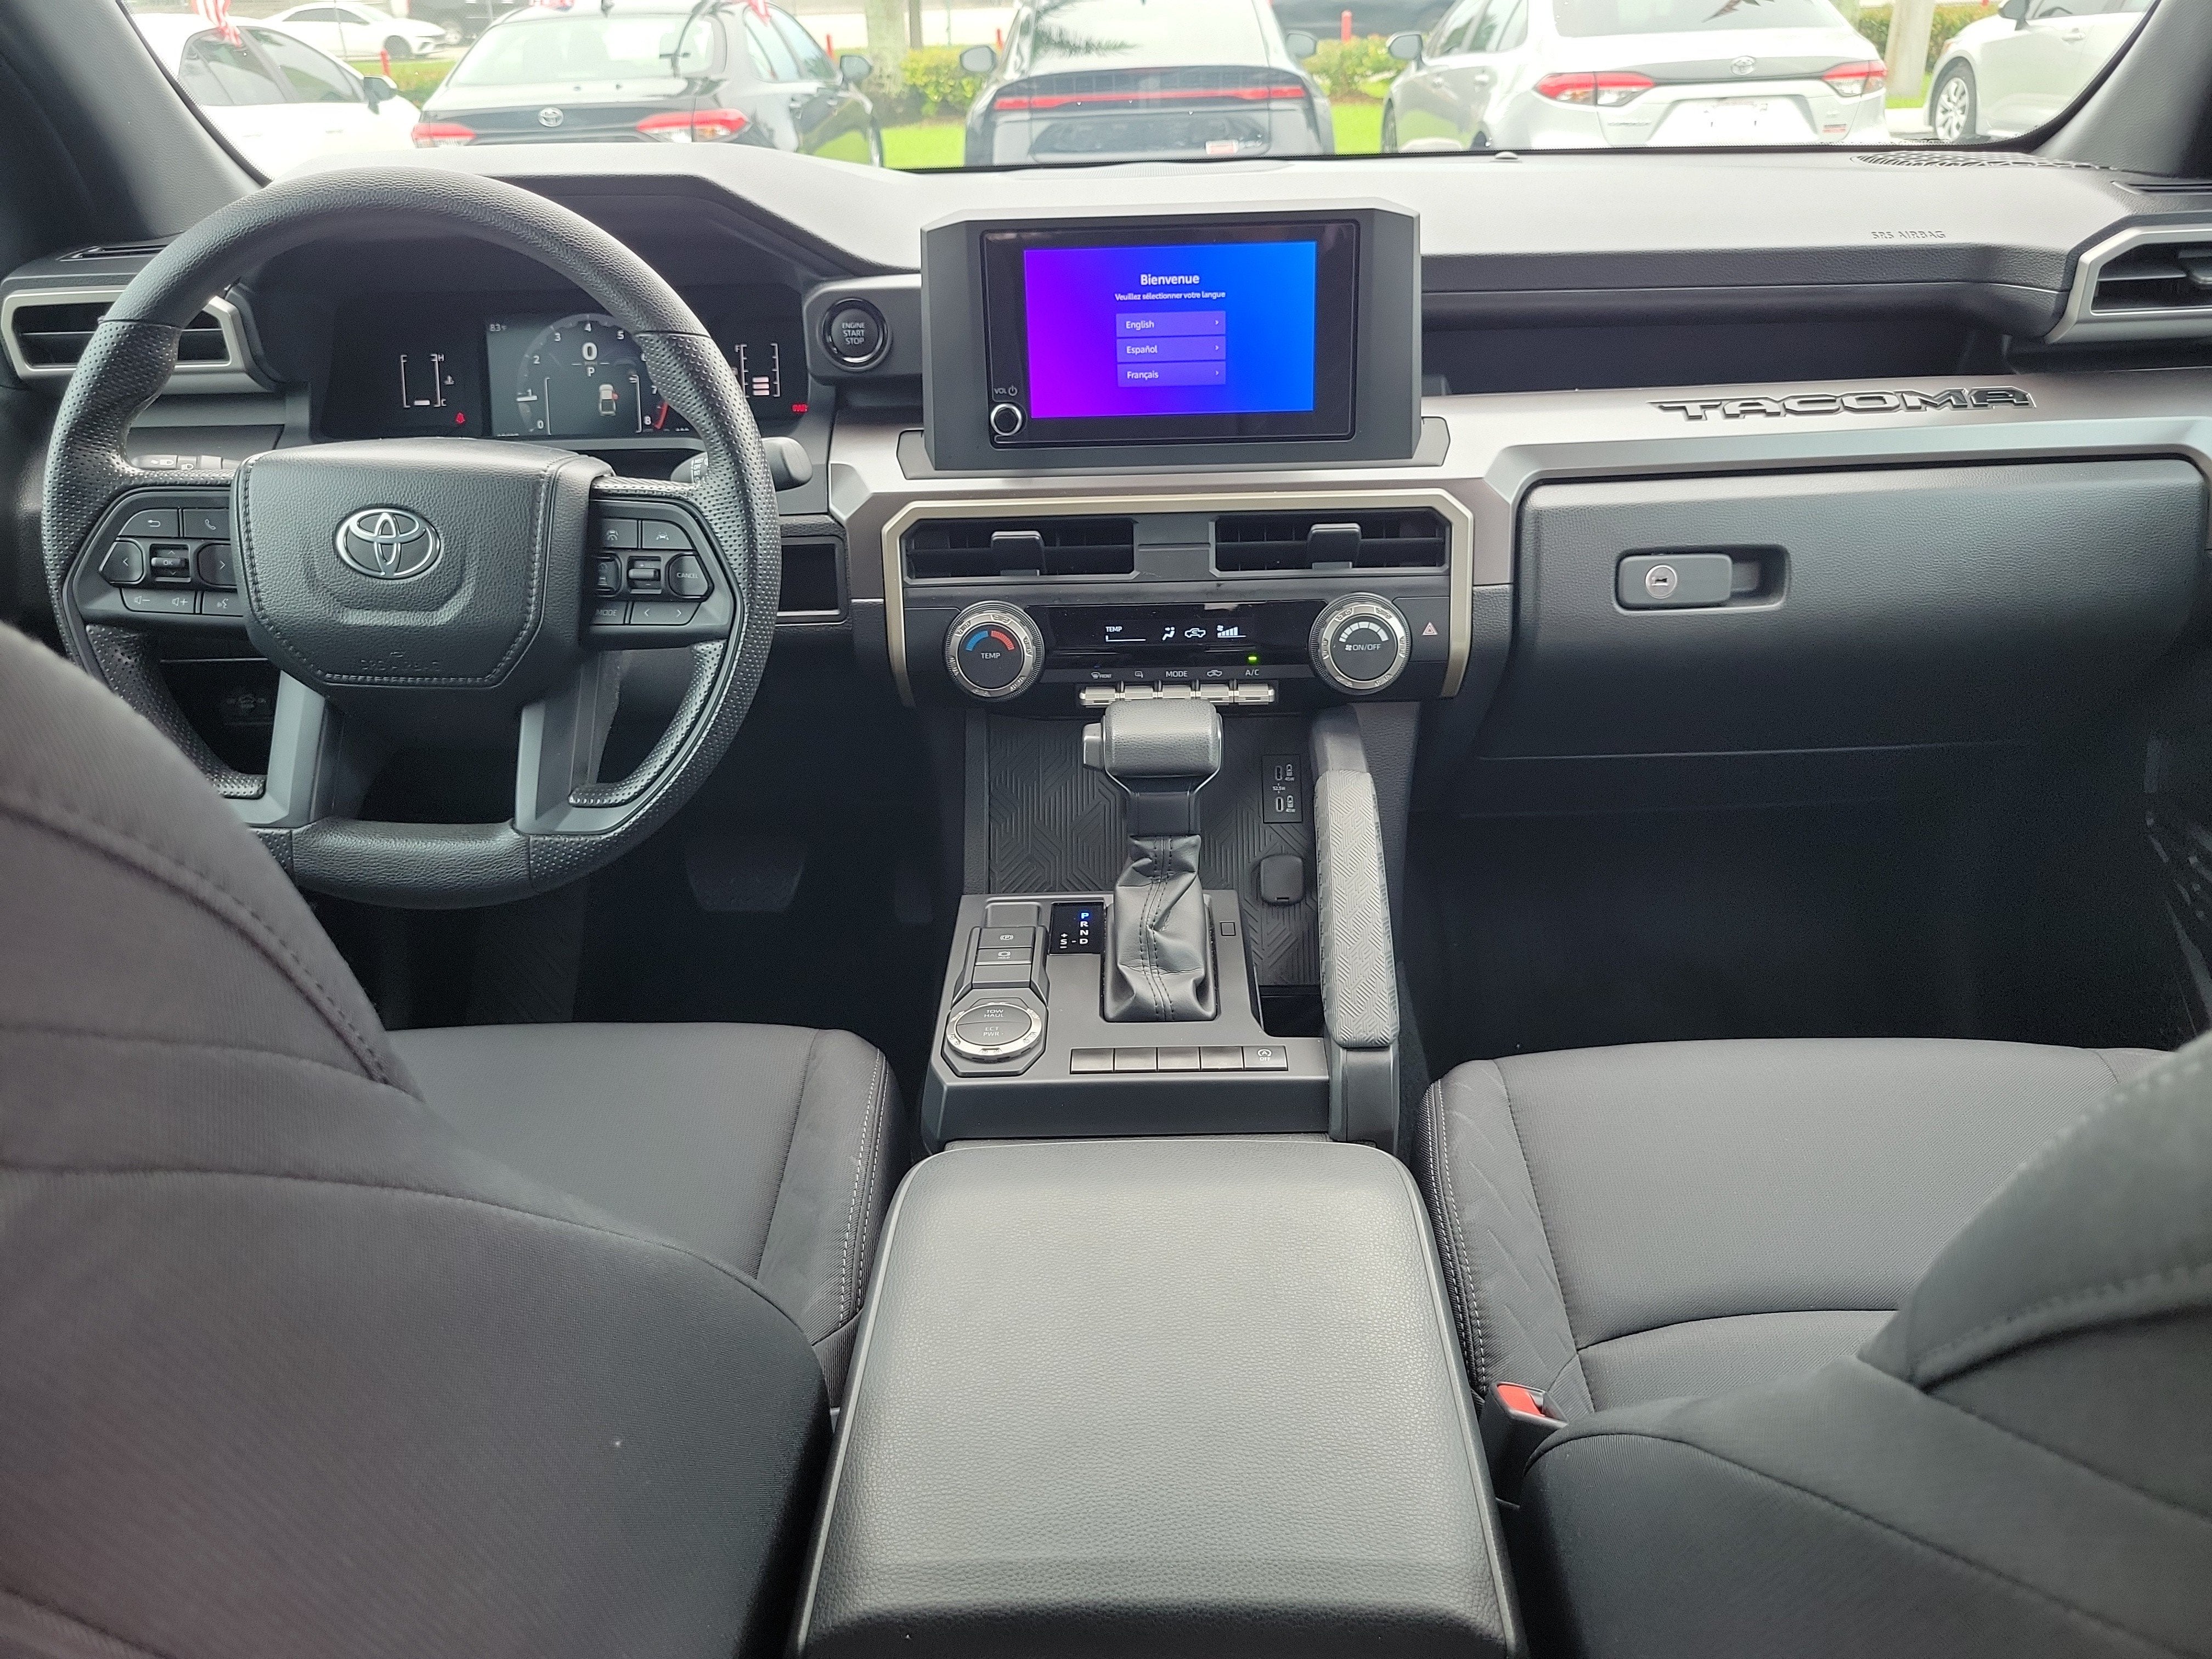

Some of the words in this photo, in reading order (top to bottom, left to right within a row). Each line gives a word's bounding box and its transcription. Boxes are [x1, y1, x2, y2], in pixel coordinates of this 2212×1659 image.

[1871, 231, 1894, 239] SRS
[1898, 230, 1946, 239] AIRBAG
[1140, 274, 1200, 286] Bienvenue
[1142, 292, 1183, 300] sélectionner
[1201, 291, 1226, 300] langue
[1126, 320, 1155, 331] English
[554, 332, 561, 342] 3
[617, 330, 625, 340] 5
[845, 337, 865, 345] STOP
[582, 342, 598, 360] 0
[1126, 345, 1158, 356] Español
[533, 354, 541, 364] 2
[586, 367, 595, 377] P
[1127, 370, 1159, 380] Français
[651, 385, 658, 394] 7
[1646, 385, 2036, 421] TACOMA
[537, 419, 544, 429] 0
[644, 415, 652, 425] 8
